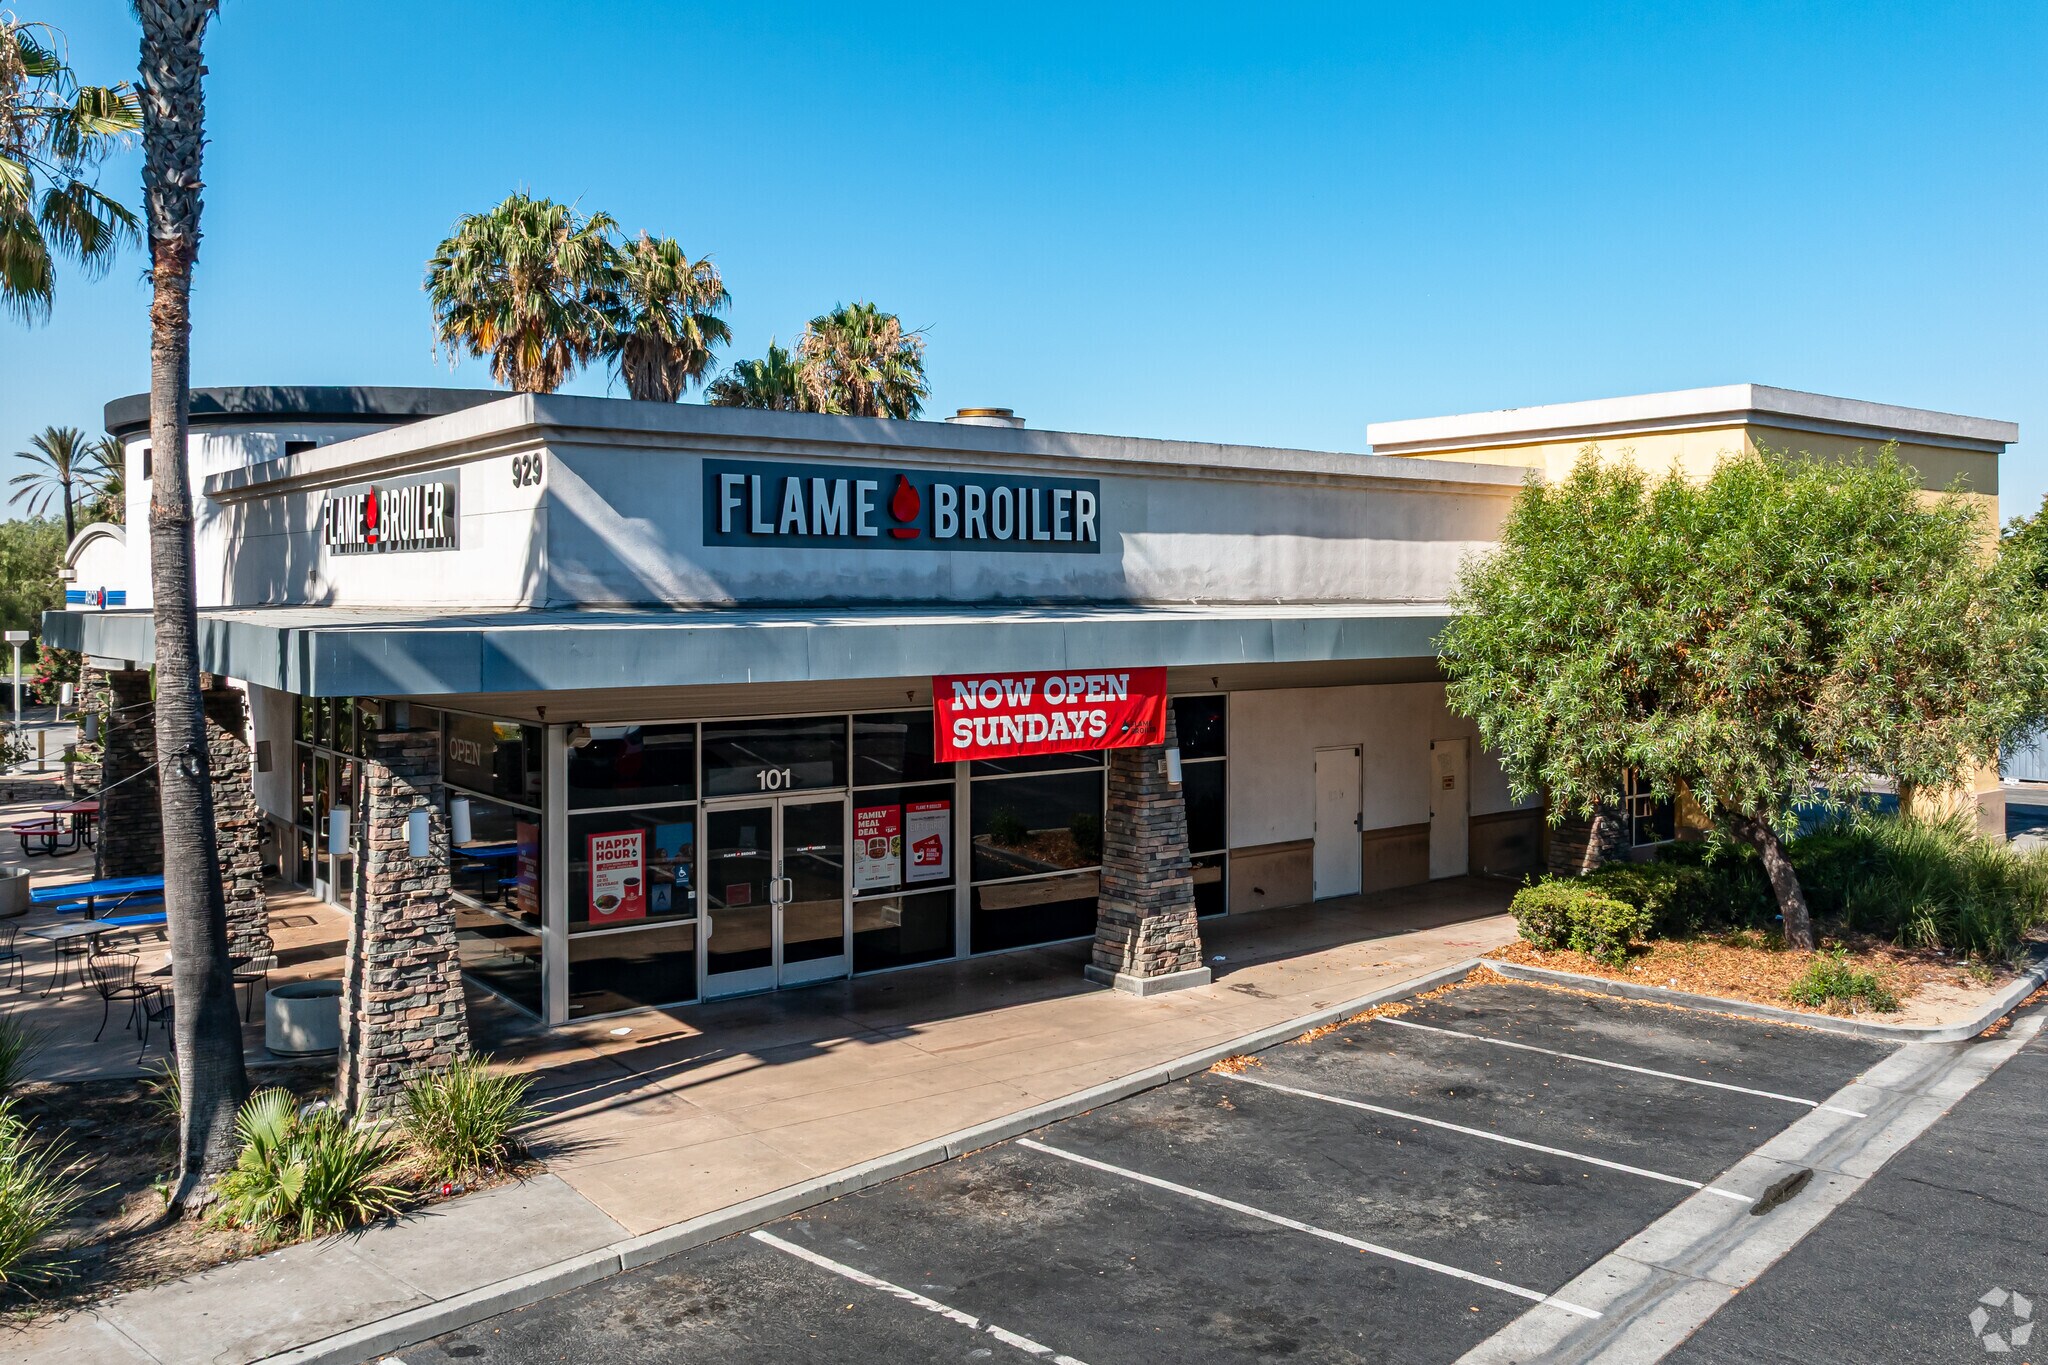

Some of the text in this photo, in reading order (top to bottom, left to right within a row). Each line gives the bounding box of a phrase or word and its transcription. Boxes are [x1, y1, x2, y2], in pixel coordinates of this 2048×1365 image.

[512, 452, 543, 488] 929
[323, 482, 446, 545] FLAME BROILER
[718, 473, 1098, 542] FLAME BROILER
[85, 591, 97, 604] ARCO
[951, 673, 1130, 711] NOW OPEN
[952, 709, 1108, 749] SUNDAYS
[450, 737, 482, 767] OPEN
[756, 768, 792, 791] 101
[858, 810, 886, 820] FAMILY
[858, 820, 879, 828] MEAL
[858, 828, 878, 836] DEAL
[596, 837, 639, 851] HAPPY
[596, 848, 631, 862] HOUR
[657, 891, 667, 902] A
